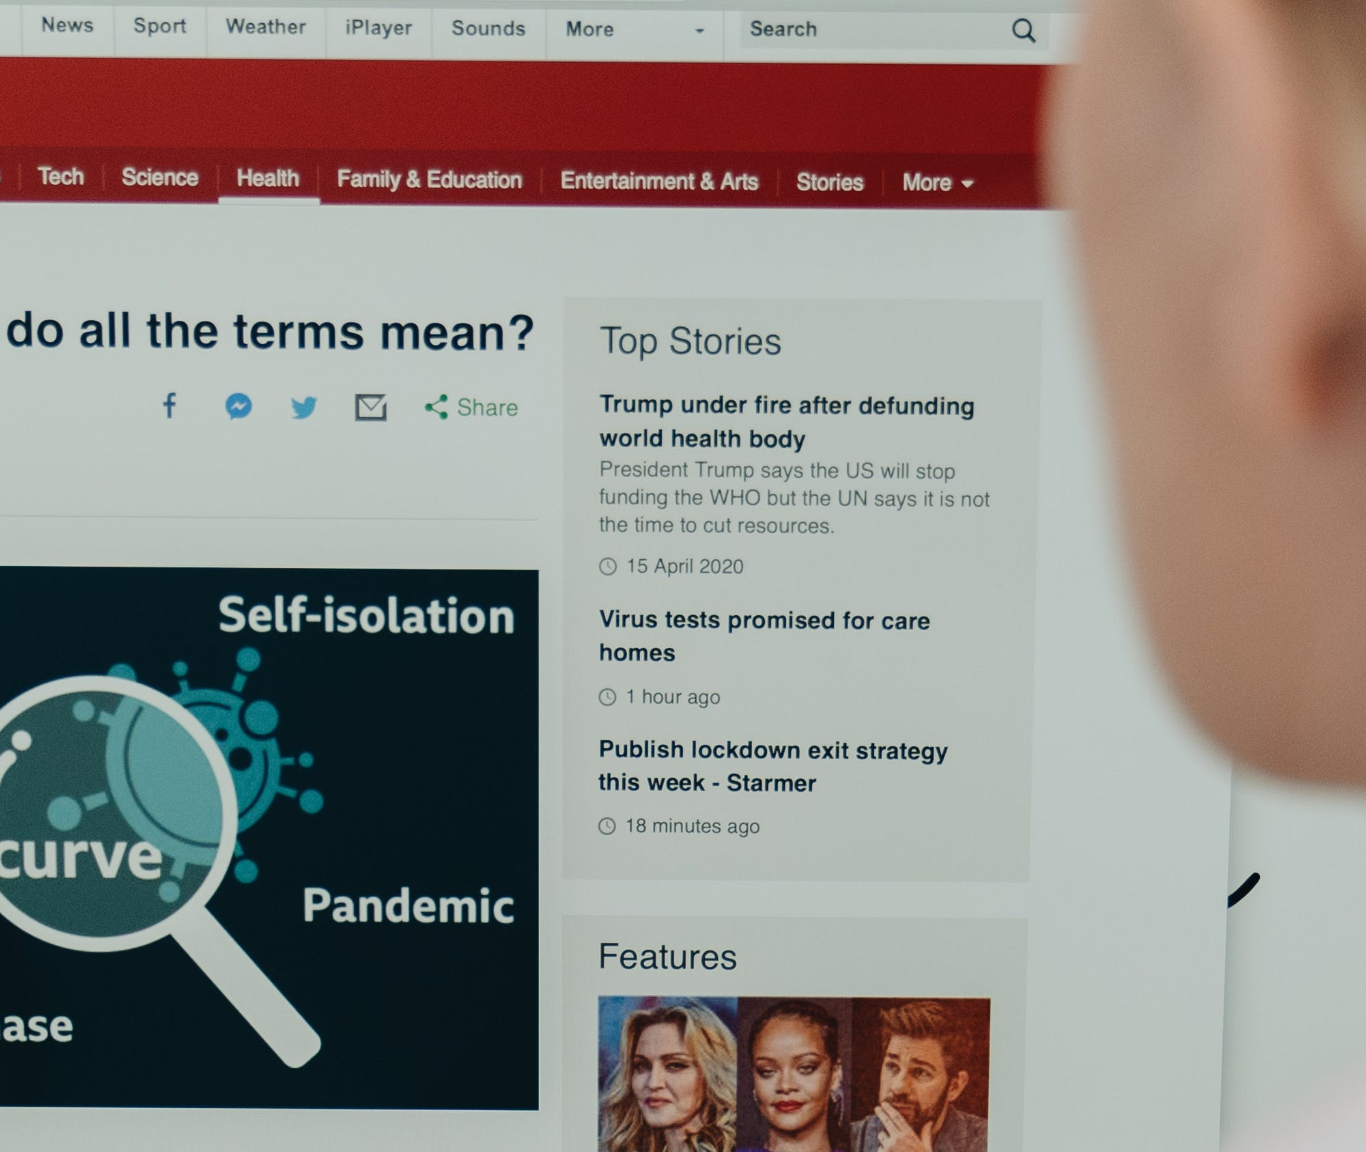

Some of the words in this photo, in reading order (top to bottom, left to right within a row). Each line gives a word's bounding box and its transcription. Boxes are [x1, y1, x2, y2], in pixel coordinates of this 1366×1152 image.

[42, 17, 93, 32] News
[134, 17, 186, 37] Sport
[226, 18, 306, 34] Weather
[347, 19, 412, 39] iPlayer
[452, 20, 525, 36] Sounds
[567, 21, 613, 36] More
[751, 20, 816, 36] Search
[37, 166, 84, 185] Tech
[122, 167, 199, 186] Science
[238, 169, 299, 187] Health
[338, 169, 402, 192] Family
[428, 169, 522, 189] Education
[562, 171, 695, 190] Entertainment
[720, 172, 759, 190] Arts
[797, 172, 864, 191] Stories
[904, 173, 952, 191] More
[7, 311, 63, 347] do
[80, 312, 129, 347] all
[147, 312, 217, 348] the
[234, 315, 363, 350] terms
[382, 314, 533, 350] mean?
[600, 326, 657, 361] Top
[670, 326, 781, 355] Stories
[458, 398, 518, 416] Share
[600, 394, 672, 418] Trump
[682, 395, 747, 413] under
[755, 395, 791, 414] fire
[799, 396, 851, 414] after
[859, 396, 974, 420] defunding
[600, 429, 662, 447] world
[672, 429, 740, 447] health
[750, 430, 805, 453] body
[601, 461, 688, 477] President
[695, 461, 754, 482] Trump
[761, 466, 803, 482] says
[811, 462, 838, 478] the
[847, 462, 874, 479] US
[881, 463, 909, 478] will
[916, 464, 955, 483] stop
[600, 488, 667, 509] funding
[675, 489, 703, 505] the
[710, 489, 760, 505] WHO
[768, 490, 796, 506] but
[802, 490, 830, 506] the
[839, 490, 867, 506] UN
[875, 494, 916, 511] says
[924, 491, 933, 506] it
[940, 491, 954, 507] is
[962, 492, 990, 507] not
[600, 516, 628, 532] the
[635, 517, 673, 533] time
[680, 518, 696, 533] to
[704, 518, 731, 533] cut
[739, 521, 834, 534] resources.
[628, 559, 647, 573] 15
[654, 558, 693, 577] April
[700, 559, 743, 574] 2020
[220, 595, 513, 634] Self-isolation
[600, 610, 657, 628] Virus
[665, 611, 720, 628] tests
[729, 611, 834, 633] promised
[843, 611, 874, 629] for
[882, 616, 930, 630] care
[600, 643, 675, 661] homes
[600, 740, 683, 758] Publish
[693, 741, 800, 759] lockdown
[809, 741, 848, 759] exit
[857, 743, 948, 765] strategy
[599, 773, 639, 791] this
[647, 774, 705, 791] week
[728, 773, 816, 792] Starmer
[627, 818, 646, 833] 18
[653, 818, 721, 833] minutes
[728, 822, 760, 837] ago
[305, 887, 514, 923] Pandemic
[601, 943, 736, 970] Features
